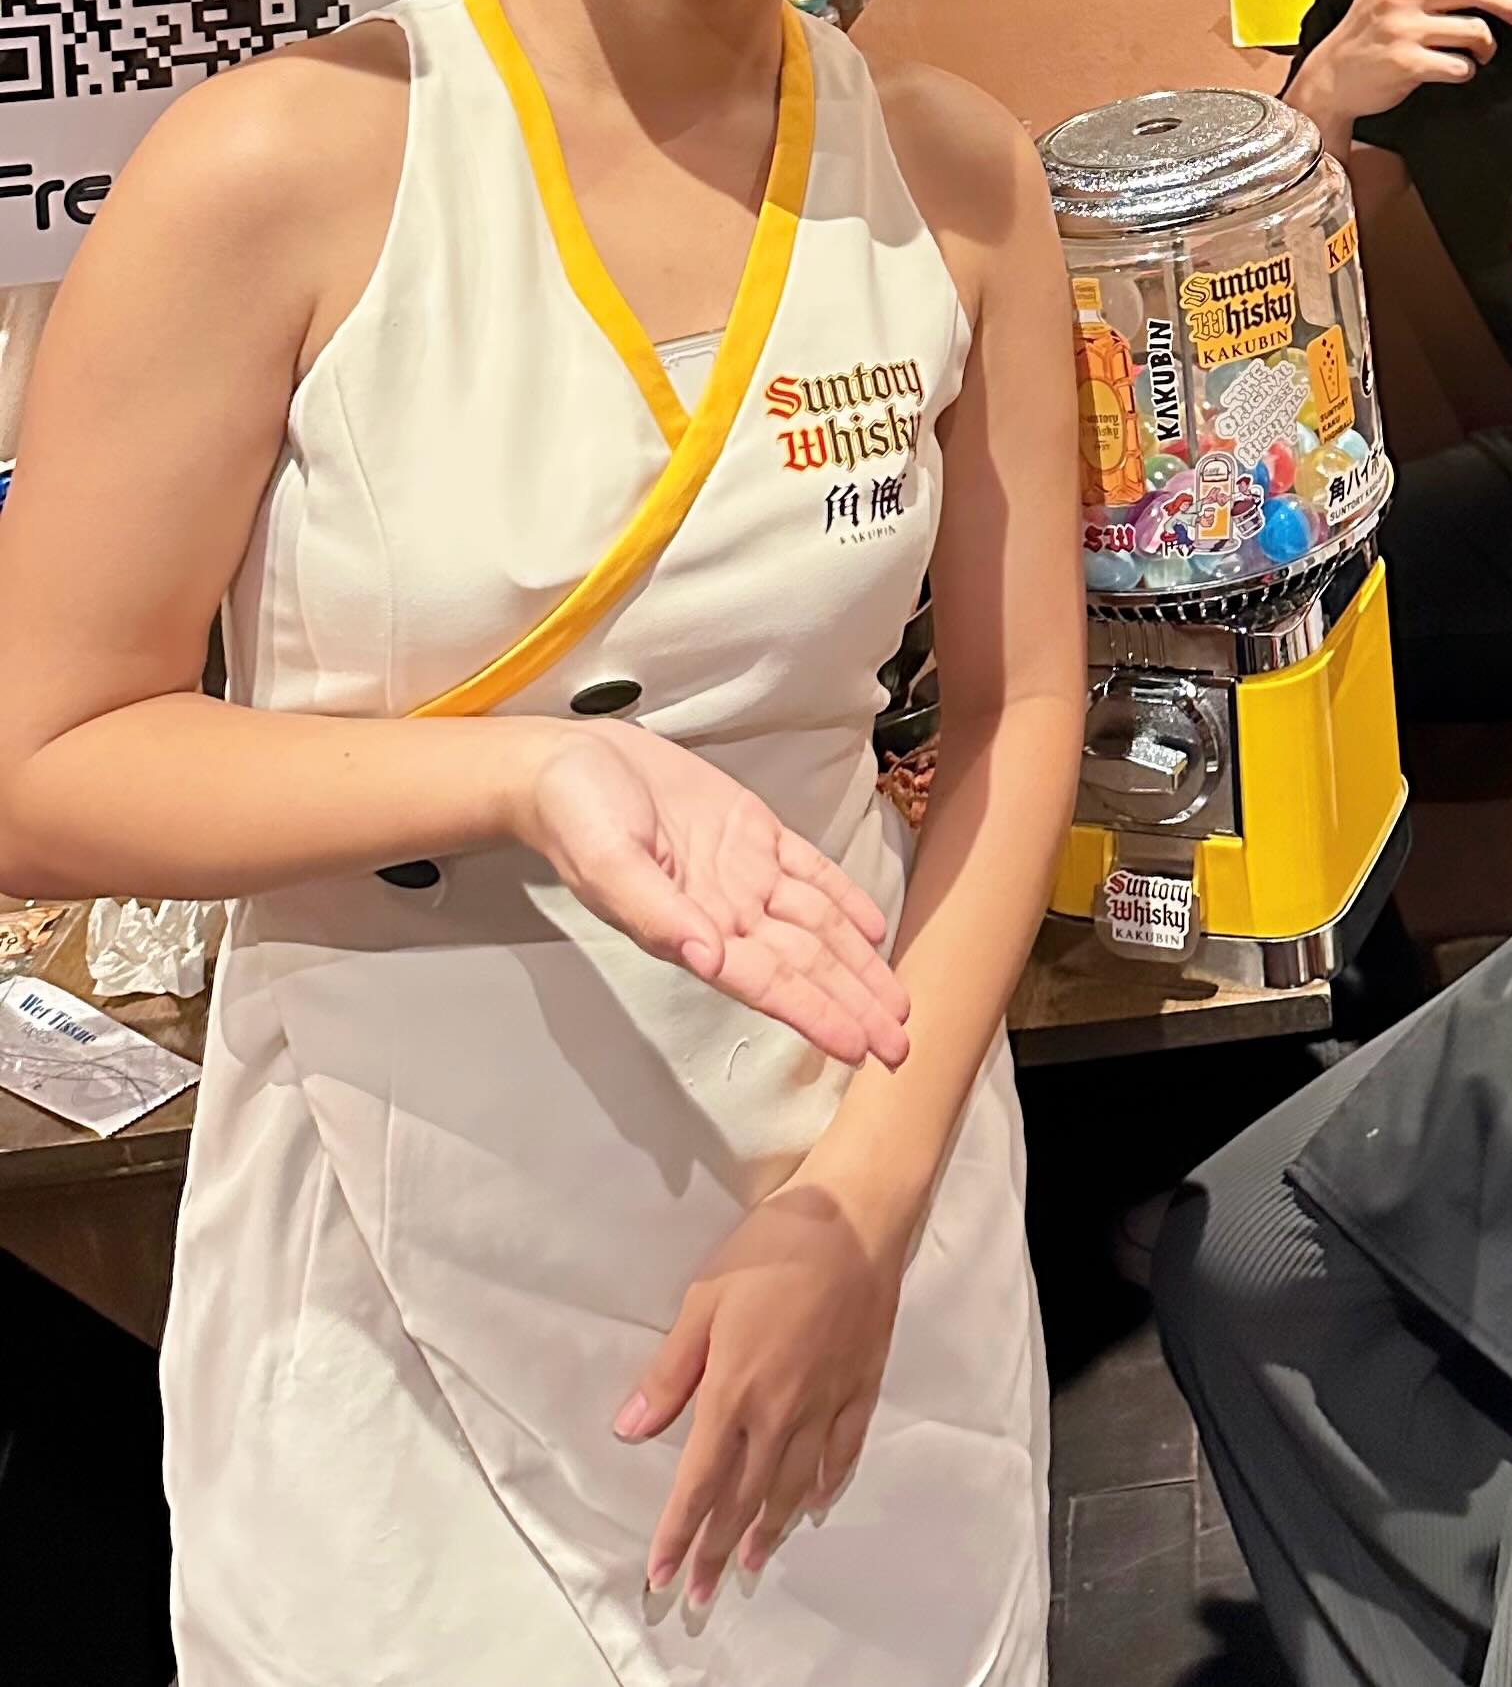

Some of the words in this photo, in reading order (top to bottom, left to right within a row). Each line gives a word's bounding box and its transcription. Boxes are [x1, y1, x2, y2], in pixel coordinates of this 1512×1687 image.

[1184, 256, 1292, 308] Suntory
[1190, 290, 1292, 341] Whisky
[1203, 328, 1289, 365] KAKUBIN
[764, 358, 925, 420] Suntory
[1147, 319, 1181, 443] KAKUBIN
[1217, 363, 1295, 437] ORIGINAL
[1319, 395, 1349, 423] SUNTORY
[775, 403, 922, 473] Whisky
[1321, 414, 1342, 433] KAKU
[1329, 494, 1364, 522] SUNTORY
[1083, 523, 1135, 553] SW
[1107, 872, 1190, 907] Suntory
[1108, 898, 1187, 933] Whisky
[1115, 928, 1181, 947] KAKUBIN
[19, 993, 49, 1020] Wet
[48, 1008, 97, 1045] Tissue
